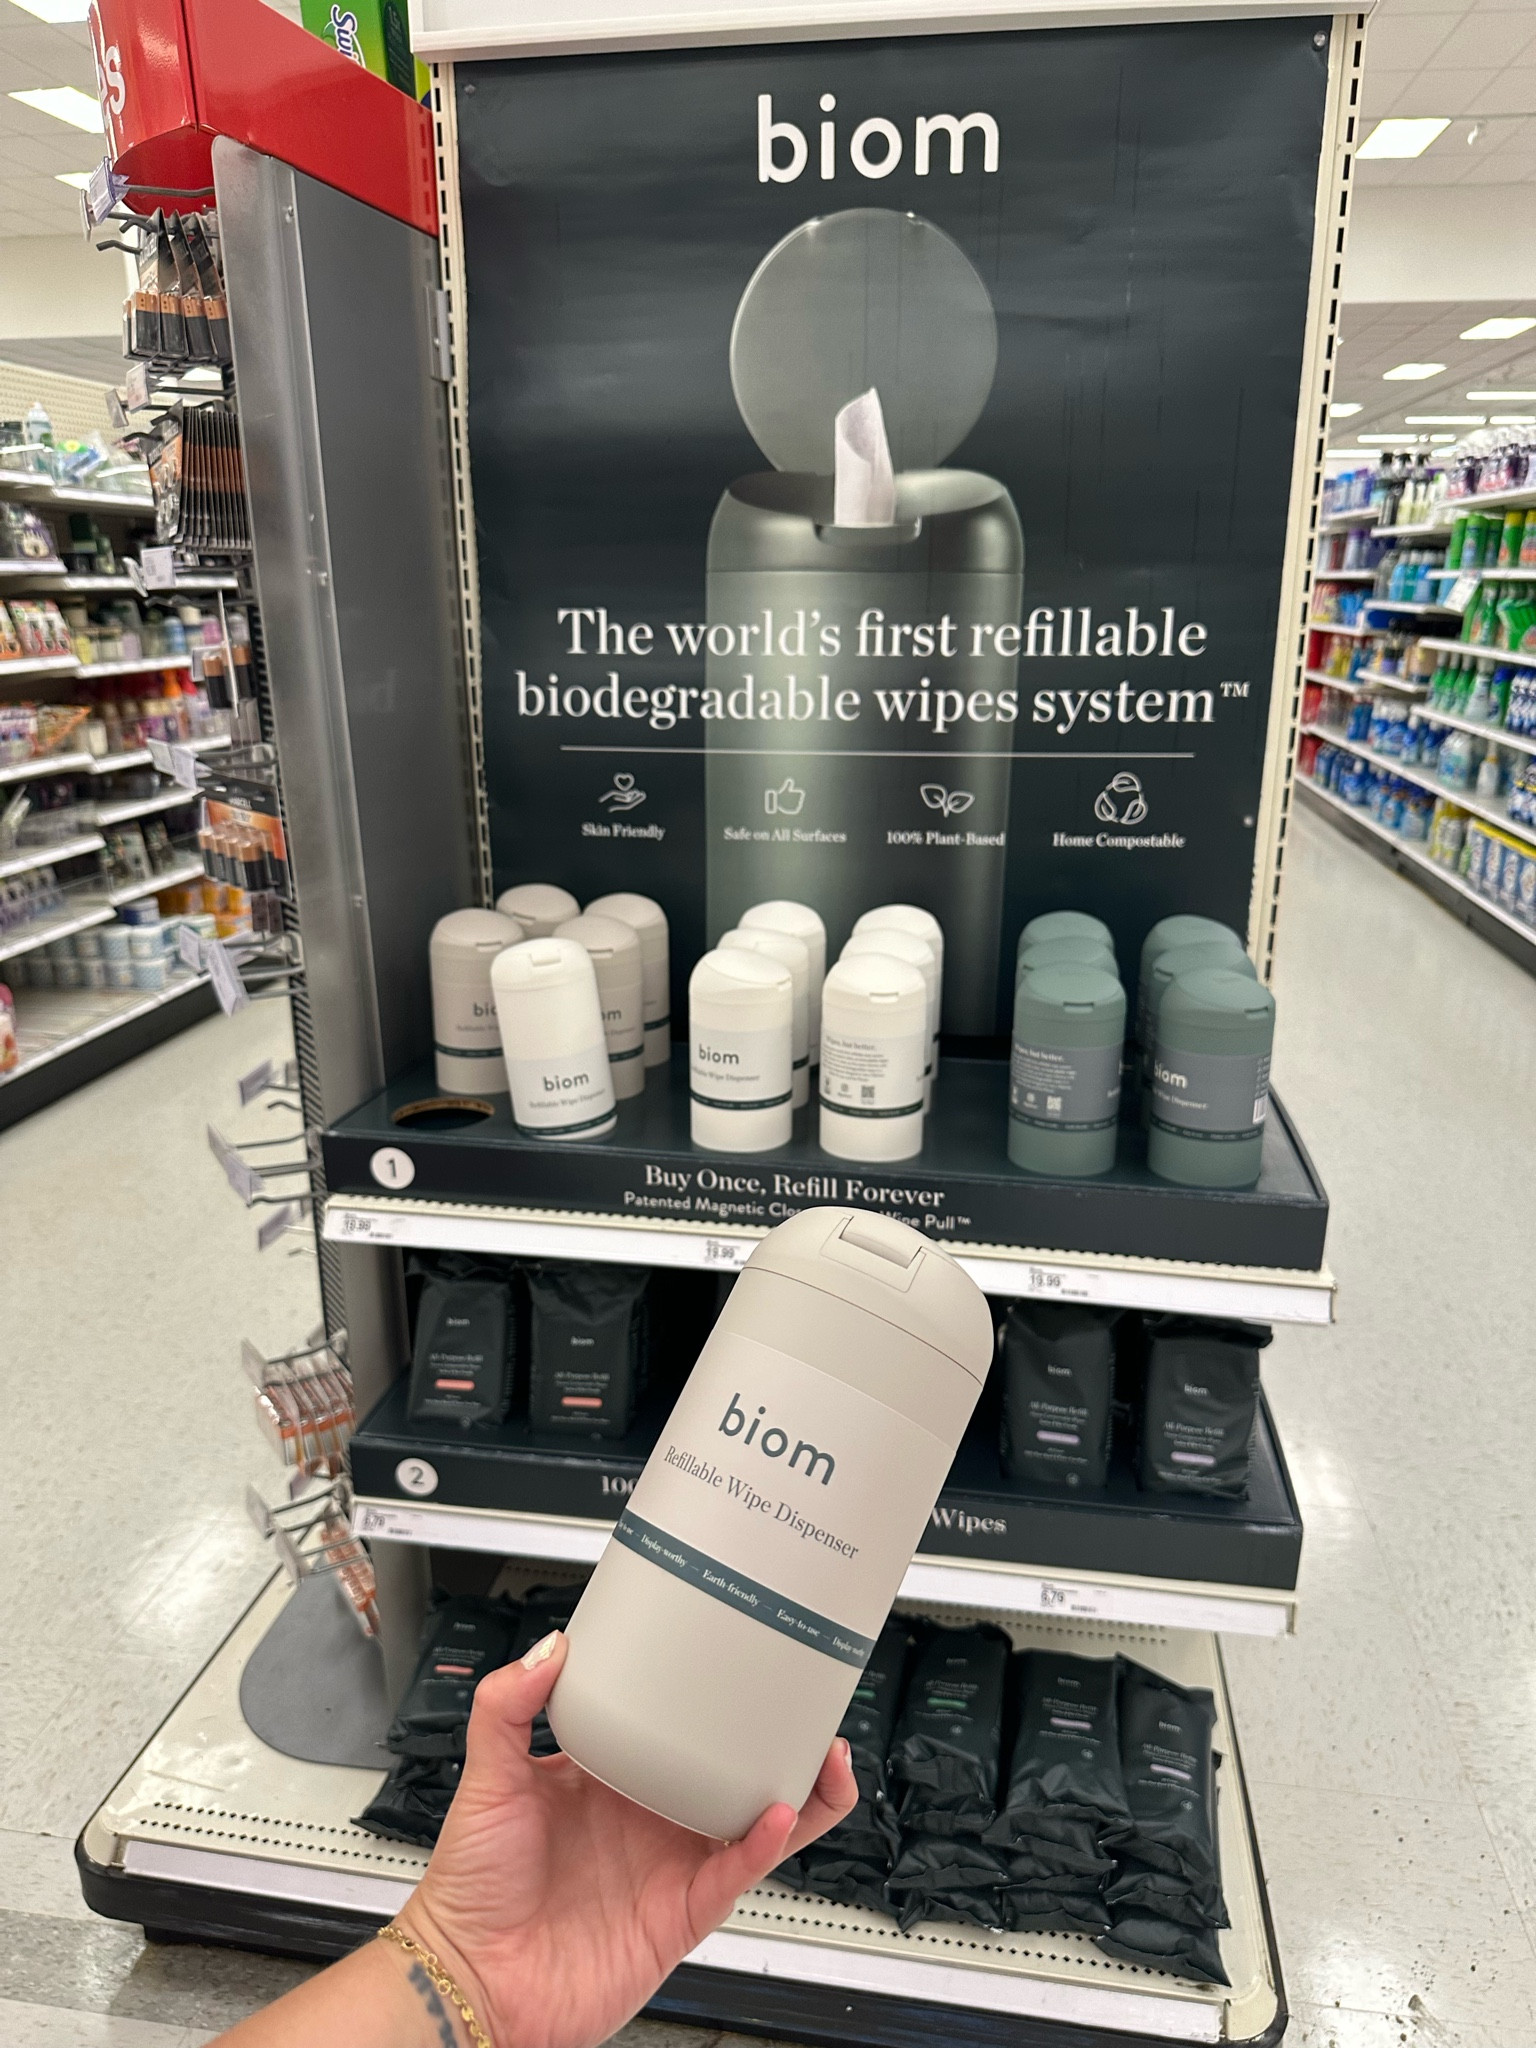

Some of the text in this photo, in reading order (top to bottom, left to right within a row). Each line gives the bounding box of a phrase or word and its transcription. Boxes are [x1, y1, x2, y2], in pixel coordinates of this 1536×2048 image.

[757, 93, 1000, 184] biom
[557, 606, 1208, 657] The world’s first refillable
[514, 669, 861, 730] biodegradable
[874, 676, 1019, 734] wipes
[580, 822, 666, 842] Skin Friendly
[723, 826, 847, 843] Safe on All Surfaces
[886, 830, 1006, 847] 100% Plant-Based
[1052, 832, 1187, 850] Home Compostable
[699, 1043, 740, 1065] biom
[543, 1073, 590, 1092] biom
[387, 1157, 397, 1179] 1
[645, 1164, 946, 1208] Buy Once, Refill Forever
[623, 1190, 692, 1211] Patented
[694, 1196, 765, 1218] Magnetic
[768, 1201, 801, 1218] Clo
[1030, 1273, 1061, 1288] 19.99
[717, 1392, 836, 1486] biom
[409, 1465, 425, 1486] 2
[664, 1445, 860, 1559] Refillable Wipe Dispenser
[931, 1507, 1008, 1537] Wipes
[641, 1533, 687, 1568] Display-worthy
[702, 1568, 760, 1608] Earth-friendly
[776, 1608, 821, 1638] Easy-to-use
